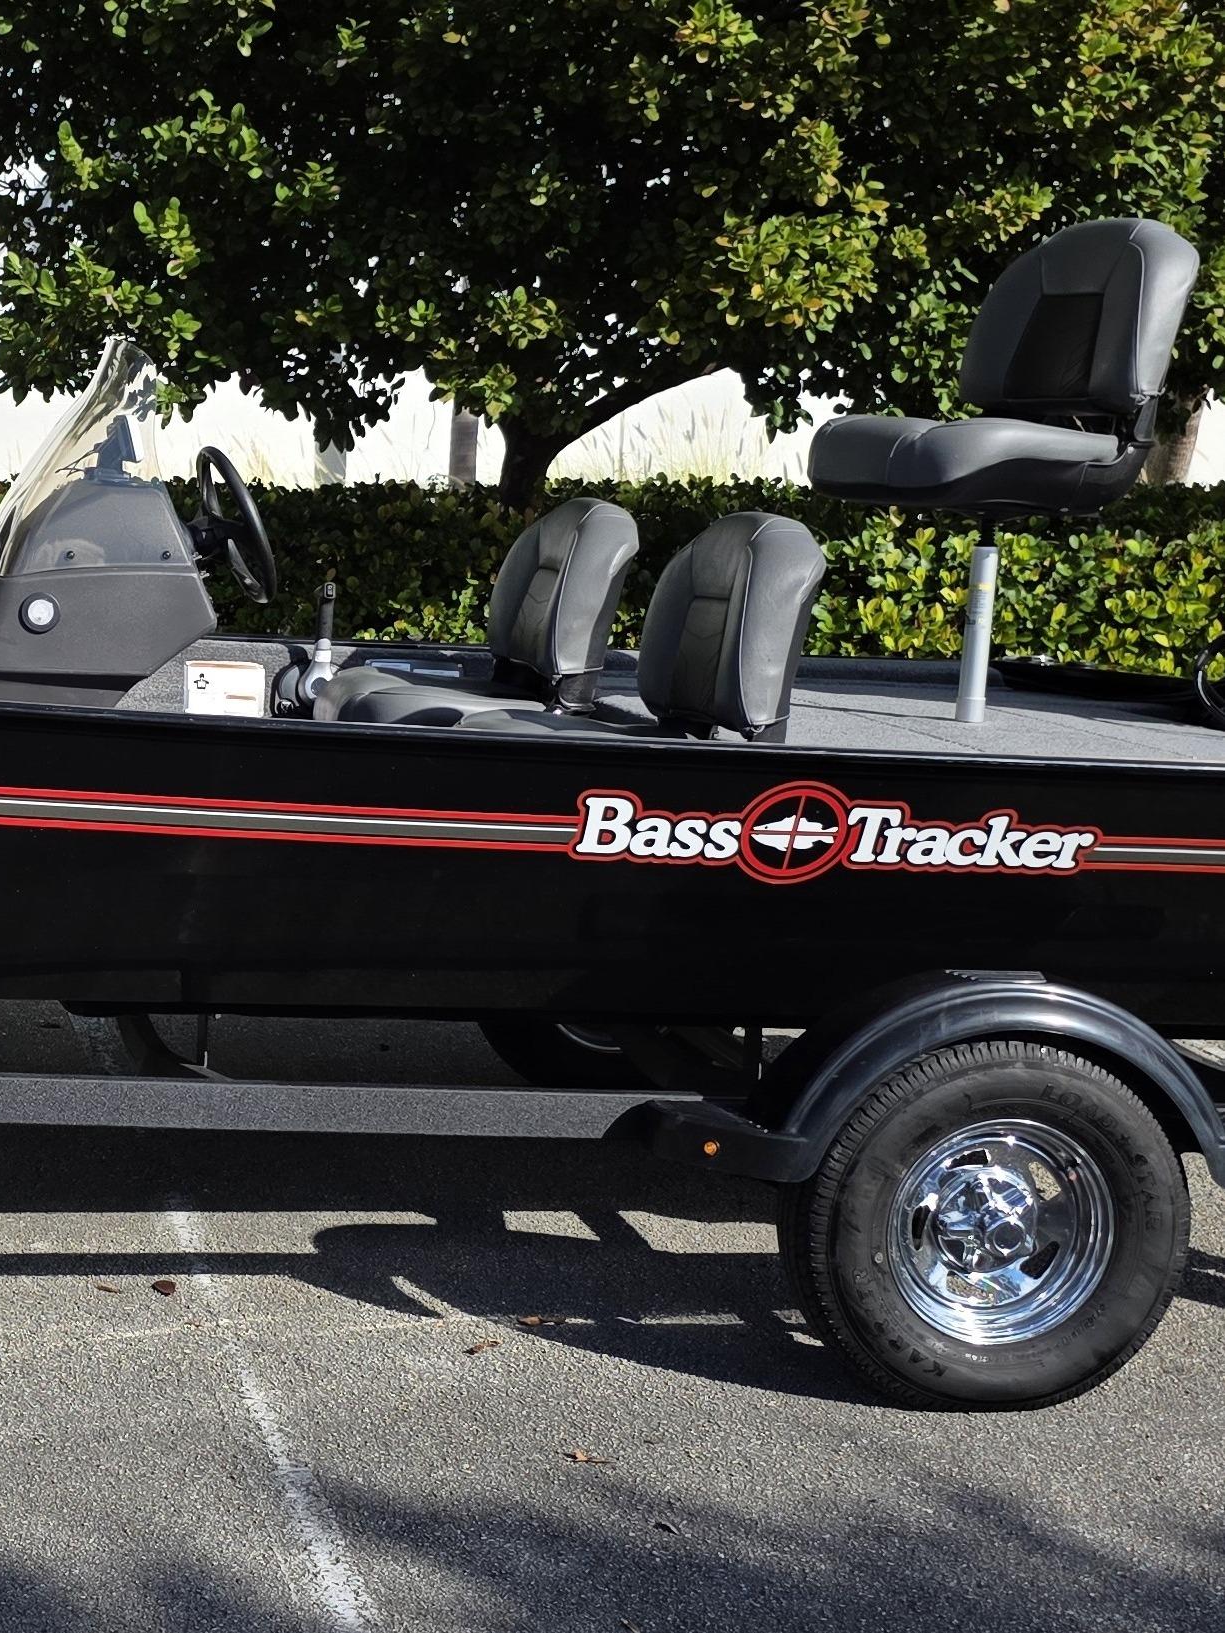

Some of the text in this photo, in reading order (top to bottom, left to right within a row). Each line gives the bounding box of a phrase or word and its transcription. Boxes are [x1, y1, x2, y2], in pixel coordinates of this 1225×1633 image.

[576, 797, 1095, 869] Bass Tracker
[1039, 1083, 1162, 1231] LOAD STAR
